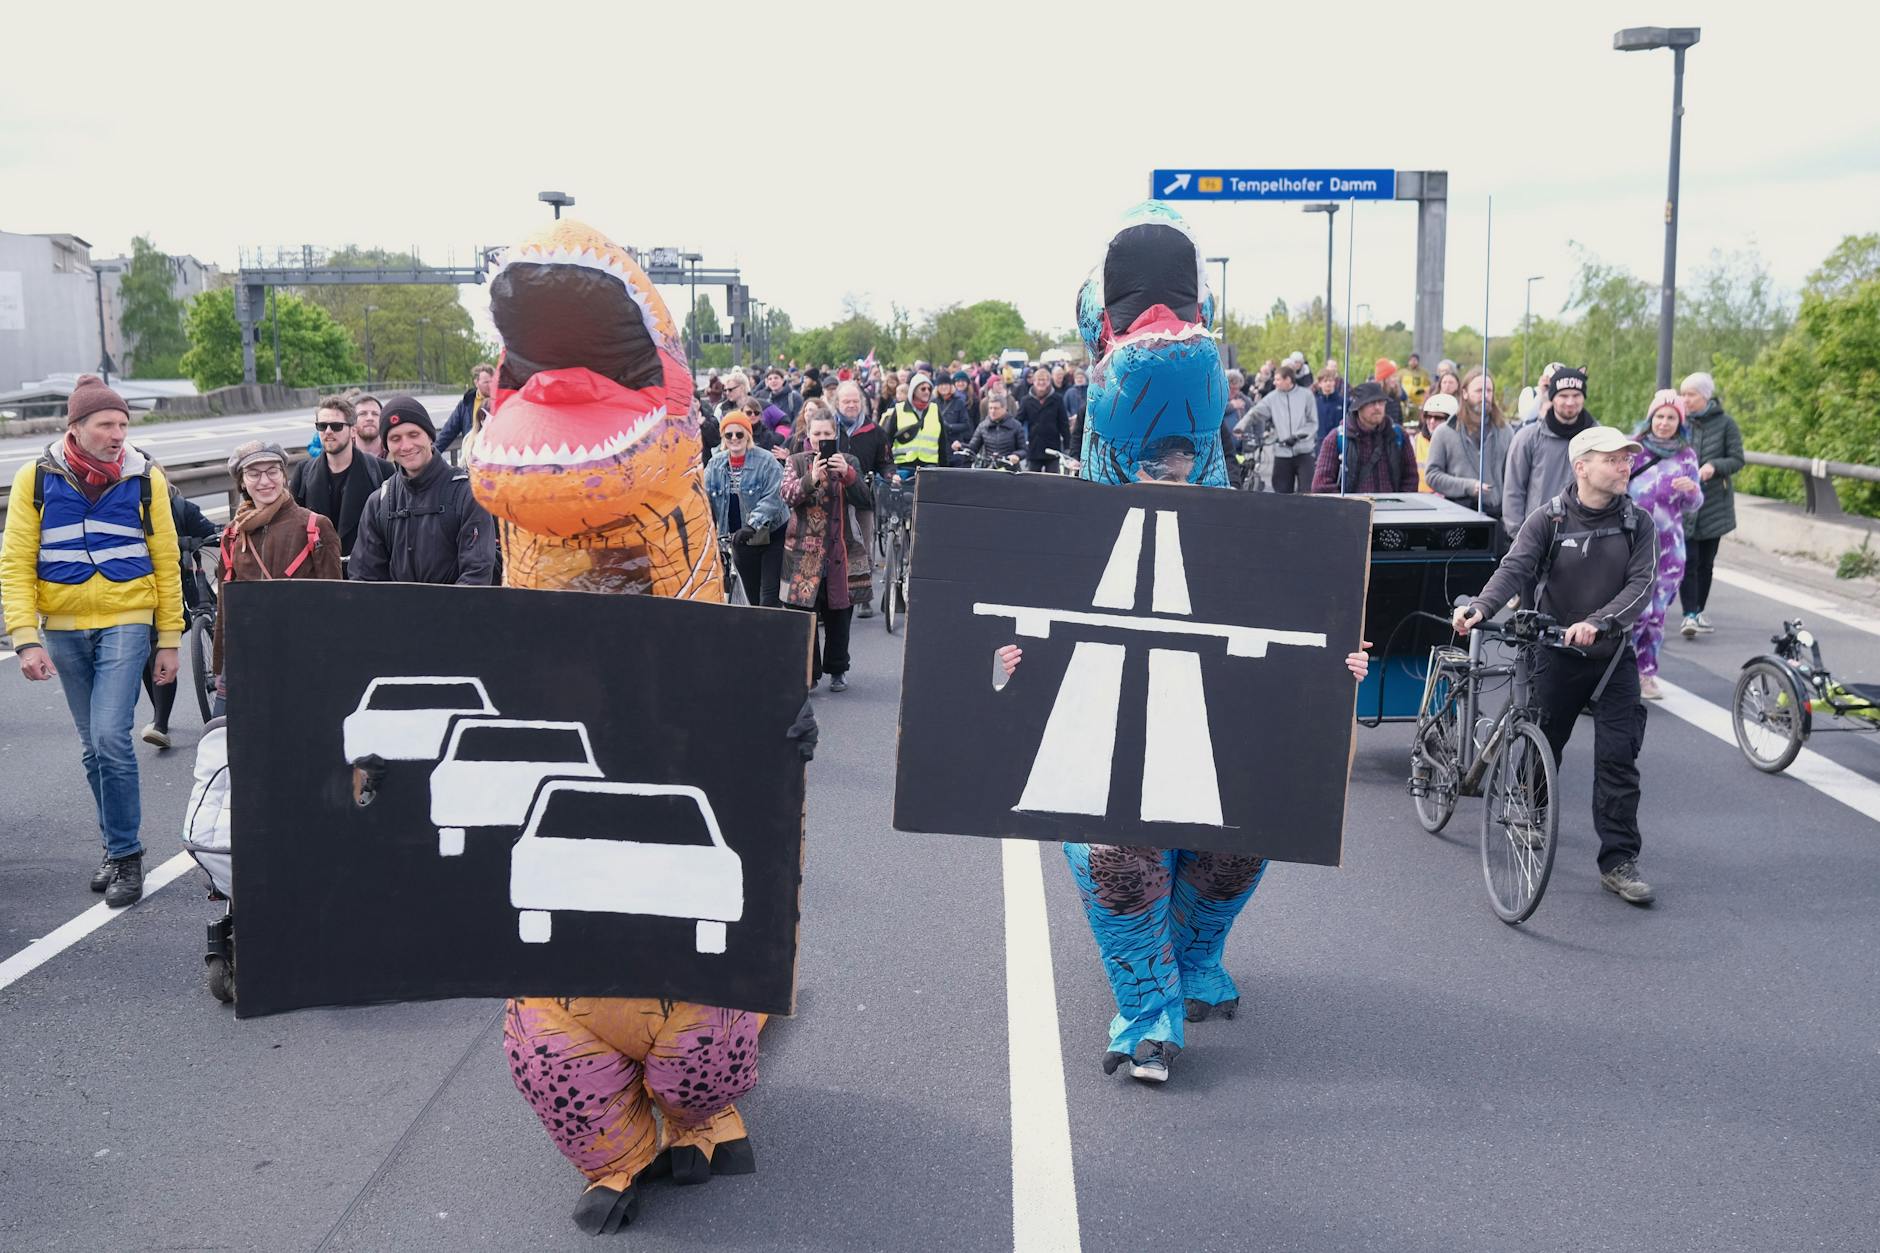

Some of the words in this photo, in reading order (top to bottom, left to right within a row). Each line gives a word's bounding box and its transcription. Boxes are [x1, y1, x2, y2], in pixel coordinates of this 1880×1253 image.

[1229, 176, 1323, 195] Tempelhofer
[1330, 177, 1377, 192] Damm
[1556, 377, 1583, 390] MEOW
